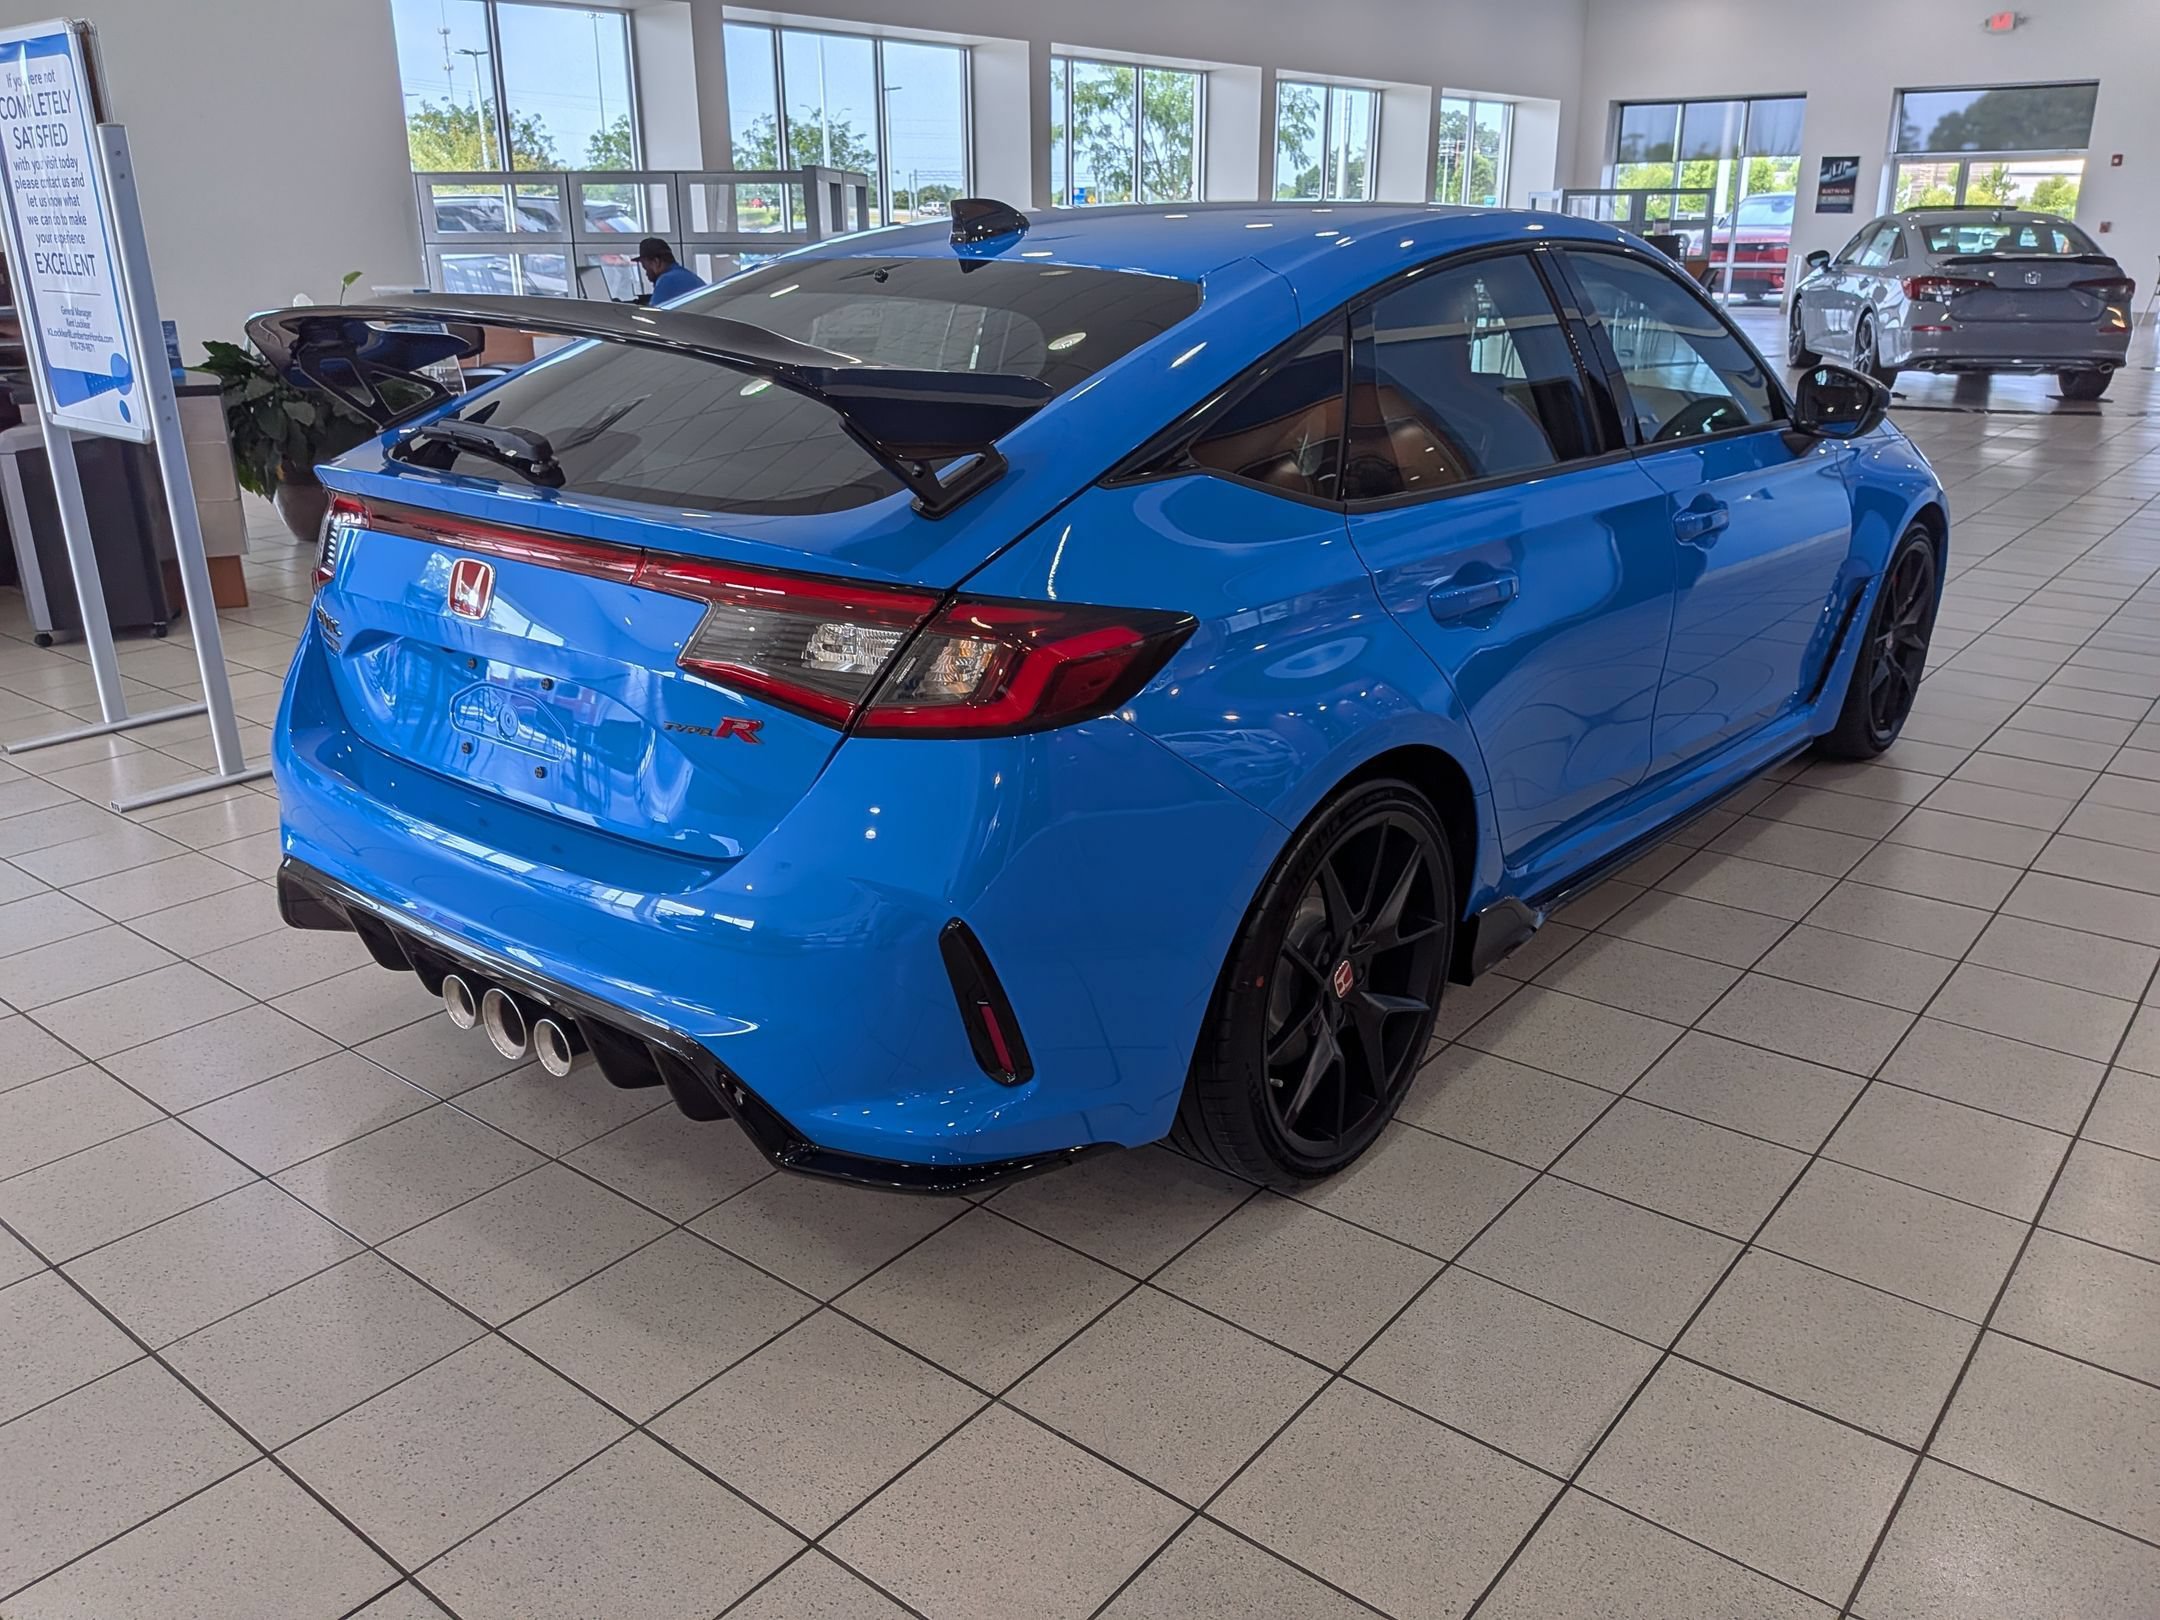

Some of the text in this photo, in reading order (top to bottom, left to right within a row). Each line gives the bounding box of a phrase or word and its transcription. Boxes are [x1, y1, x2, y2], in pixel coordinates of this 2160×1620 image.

[26, 73, 43, 86] ere
[13, 122, 69, 150] SATSFIED
[13, 153, 78, 174] with yo visit today
[14, 172, 85, 193] please ctact us and
[26, 192, 38, 208] let
[38, 197, 48, 208] us
[63, 192, 81, 207] what
[27, 215, 39, 226] we
[40, 216, 52, 226] can
[68, 210, 87, 226] make
[36, 233, 52, 248] your
[34, 252, 96, 276] EXCELLENT
[713, 716, 765, 744] R
